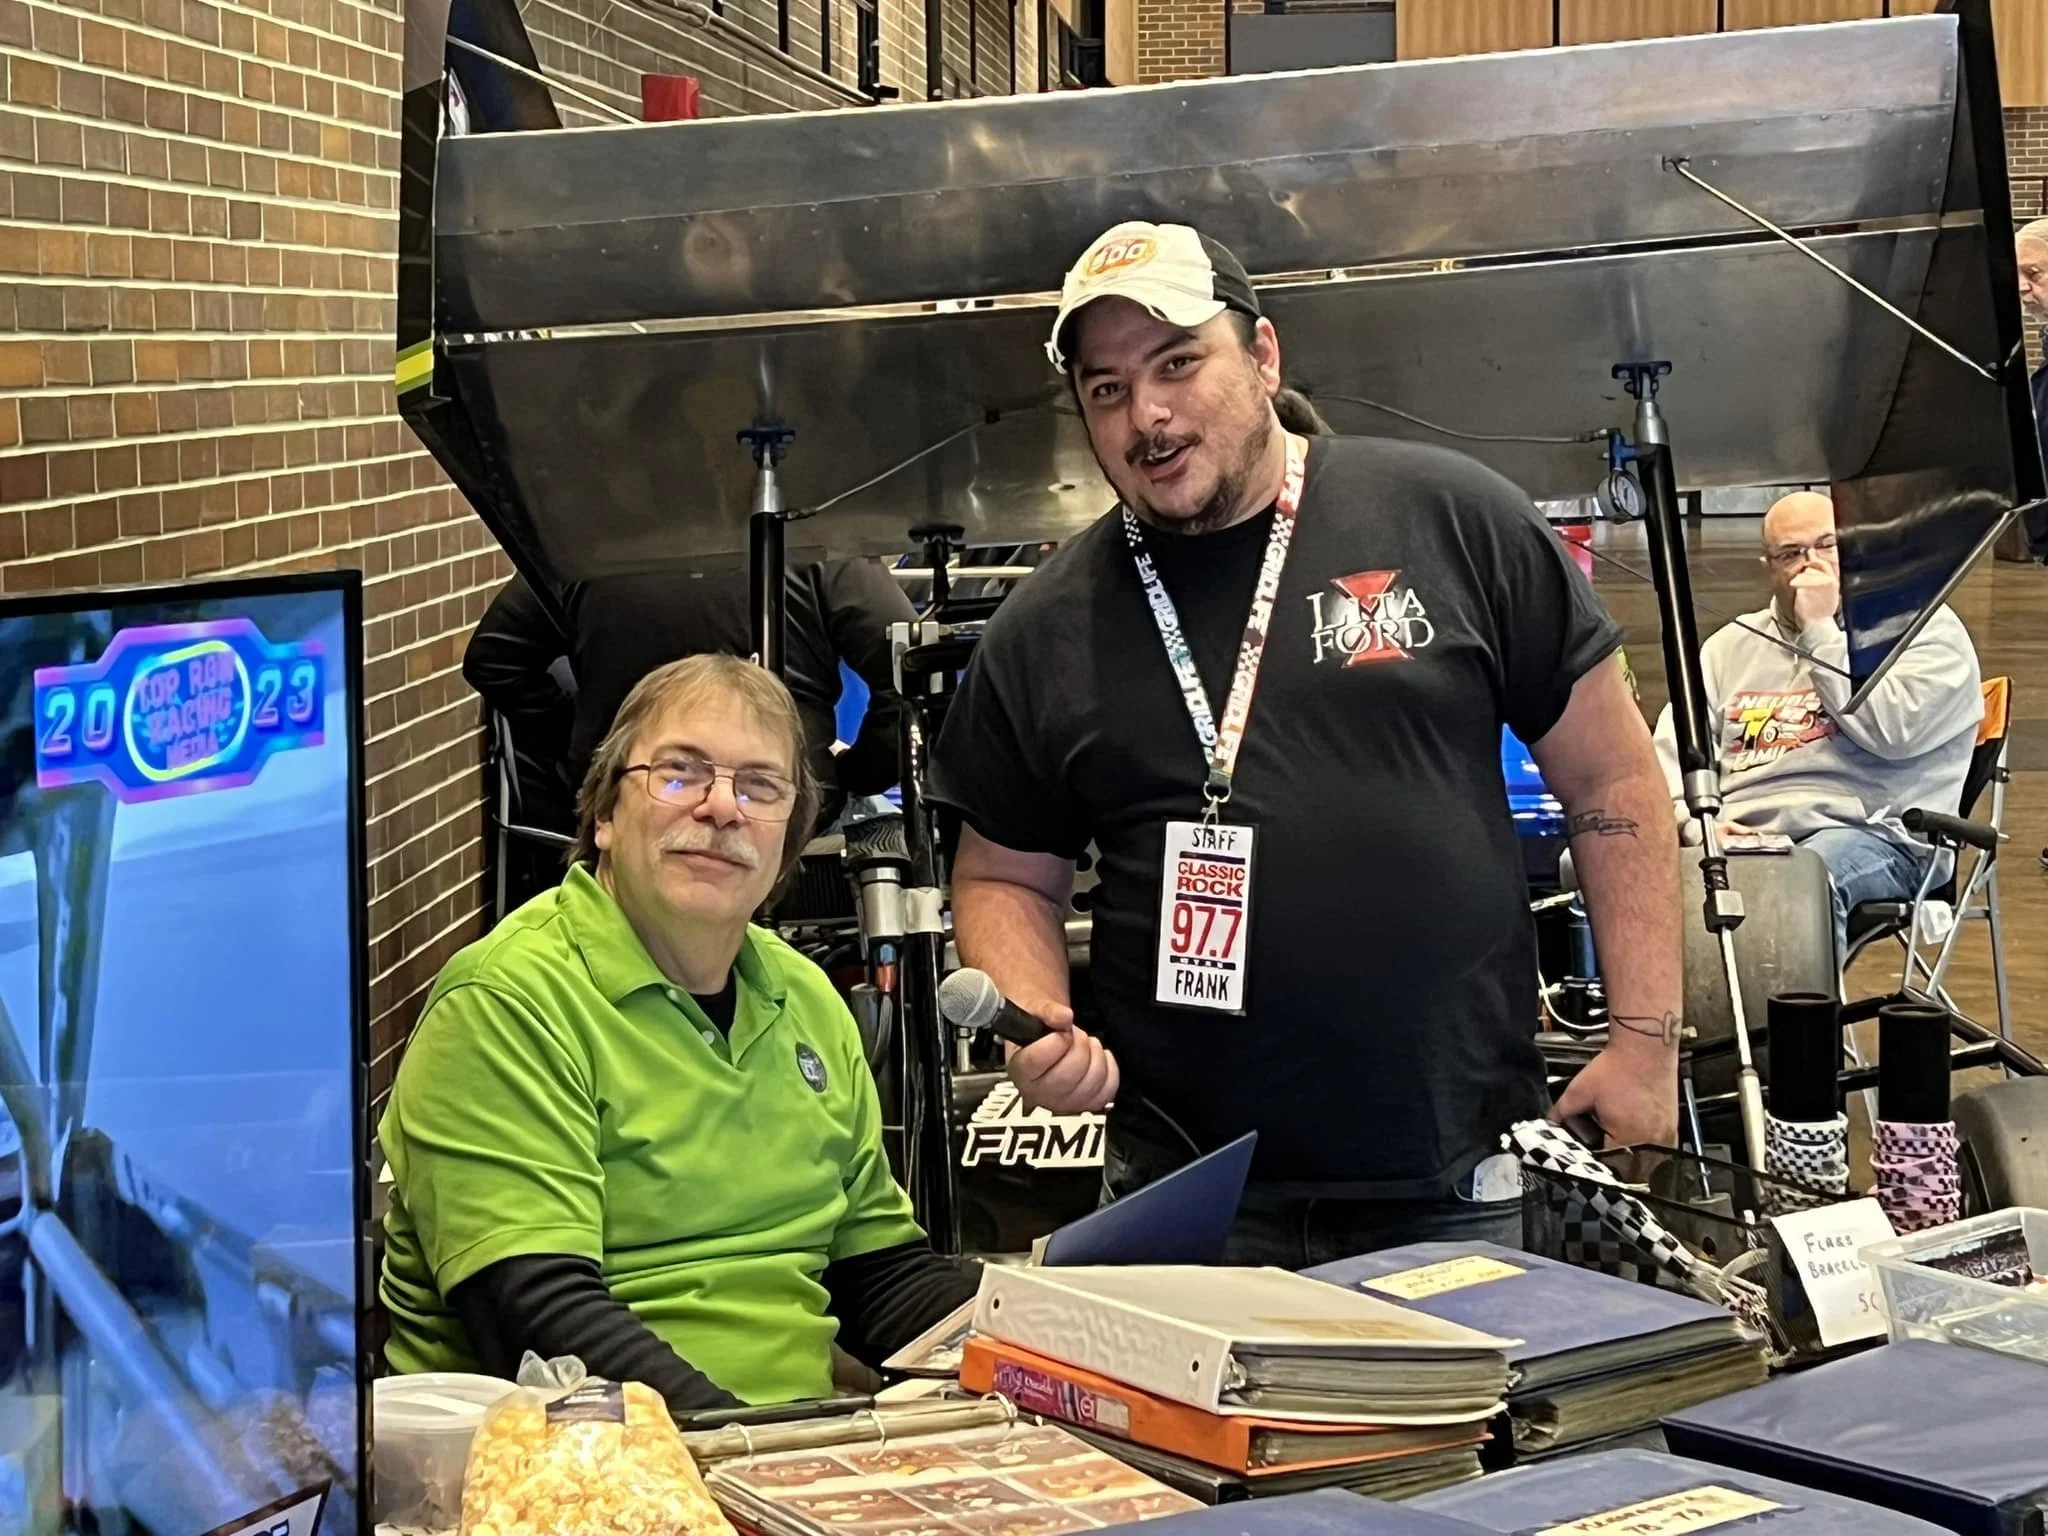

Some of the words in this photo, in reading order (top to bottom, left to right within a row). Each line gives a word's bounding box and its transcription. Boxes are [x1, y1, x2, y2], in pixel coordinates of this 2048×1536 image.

[1306, 587, 1426, 632] LITA
[1310, 616, 1435, 664] FORD
[41, 682, 117, 756] 20
[252, 658, 317, 727] 23
[1191, 827, 1238, 851] STAFF
[1176, 876, 1244, 898] ROCK
[1178, 861, 1246, 881] CLASSIC
[1171, 902, 1243, 959] 97.7
[1175, 969, 1230, 1001] FRANK
